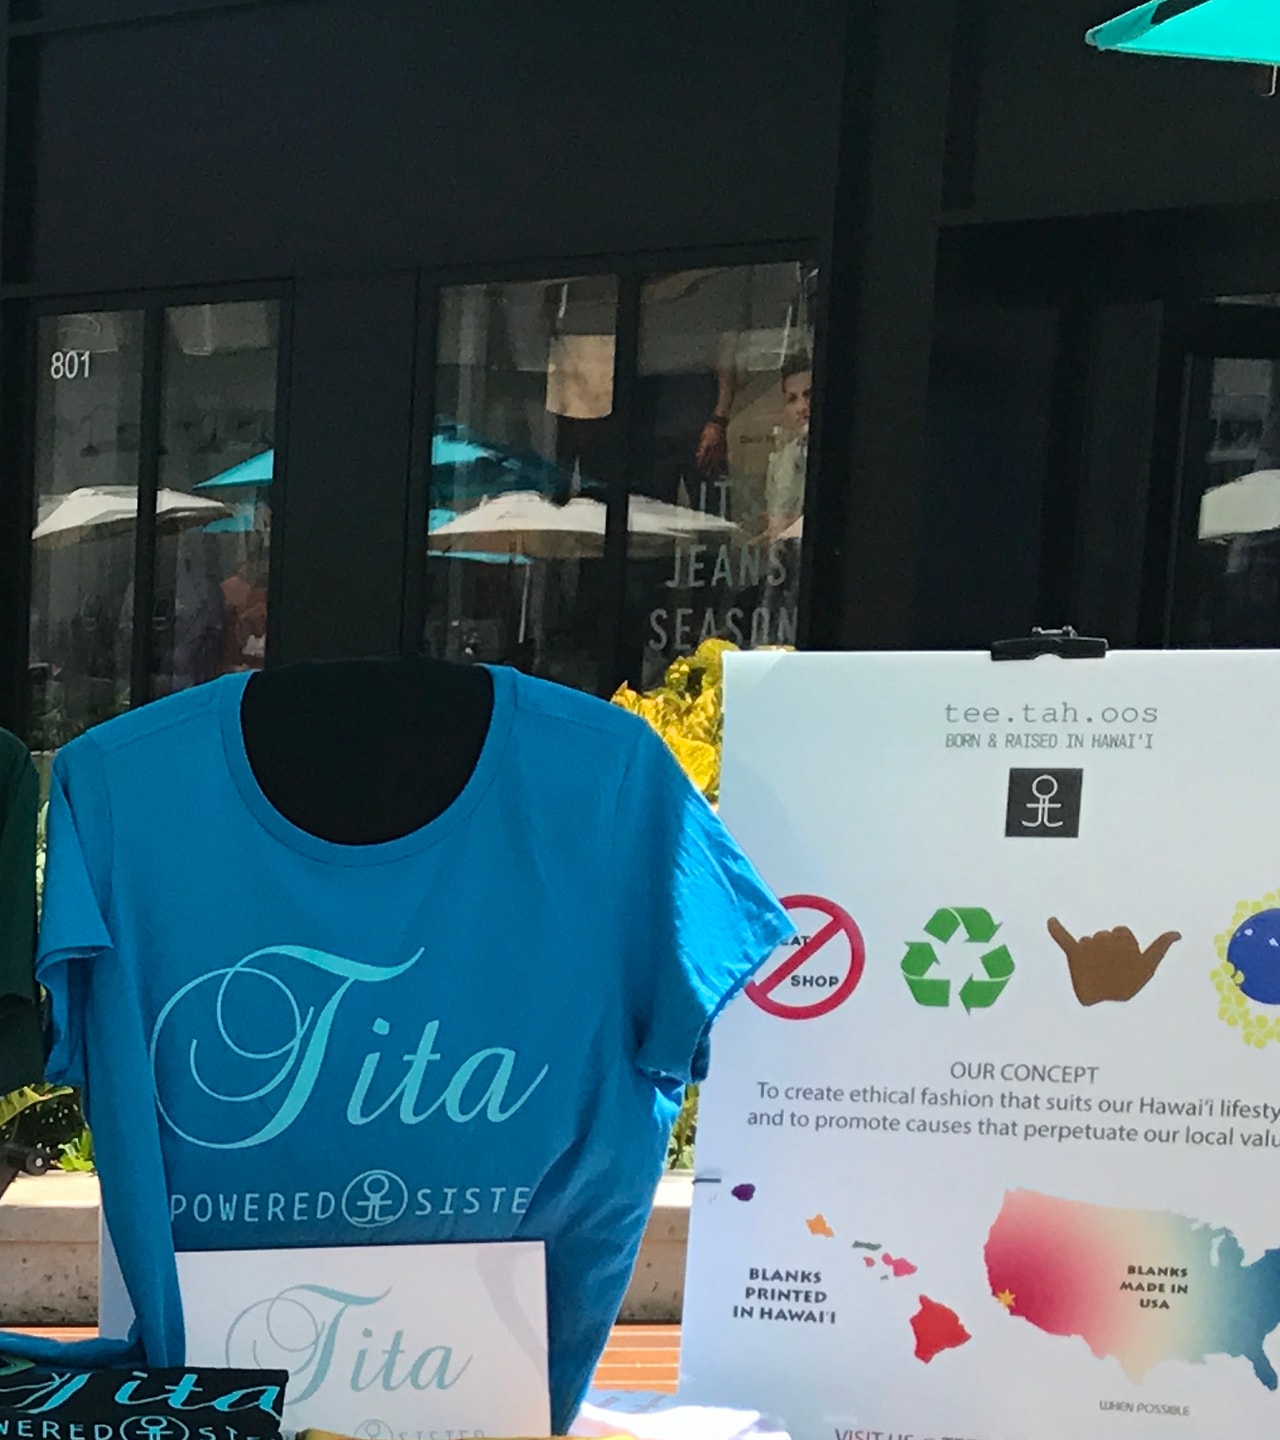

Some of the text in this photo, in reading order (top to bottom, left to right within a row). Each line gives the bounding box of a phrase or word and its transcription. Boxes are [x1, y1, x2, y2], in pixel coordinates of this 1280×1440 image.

[50, 350, 90, 379] 801
[664, 544, 787, 588] JEANS
[649, 607, 798, 651] SEASON
[944, 701, 1159, 724] tee.tah.oos
[945, 733, 981, 748] BORN
[988, 734, 998, 748] &
[1004, 733, 1059, 749] RAISED
[1065, 734, 1085, 749] IN
[790, 974, 840, 988] SHOP
[151, 945, 549, 1149] Tita
[950, 1061, 1100, 1085] OUR CONCEPT
[757, 1081, 779, 1100] To
[784, 1084, 845, 1102] create
[849, 1085, 916, 1105] ethical
[921, 1087, 994, 1109] fashion
[1000, 1091, 1041, 1110] that
[1046, 1094, 1092, 1113] suits
[1098, 1098, 1133, 1113] our
[1220, 1099, 1280, 1124] lifesty
[747, 1109, 785, 1127] and
[790, 1111, 810, 1128] to
[815, 1113, 901, 1133] promote
[906, 1117, 972, 1135] causes
[977, 1117, 1018, 1137] that
[1023, 1119, 1139, 1143] perpetuate
[1143, 1127, 1180, 1144] our
[1185, 1125, 1234, 1146] local
[169, 1186, 531, 1223] POWERED SISTE
[749, 1267, 822, 1284] BLANKS
[1127, 1264, 1189, 1278] BLANKS
[745, 1286, 828, 1304] PRINTED
[1119, 1280, 1189, 1295] MADE IN
[733, 1305, 837, 1325] IN HAWAI'I
[1139, 1298, 1170, 1310] USA
[225, 1283, 474, 1407] Tita
